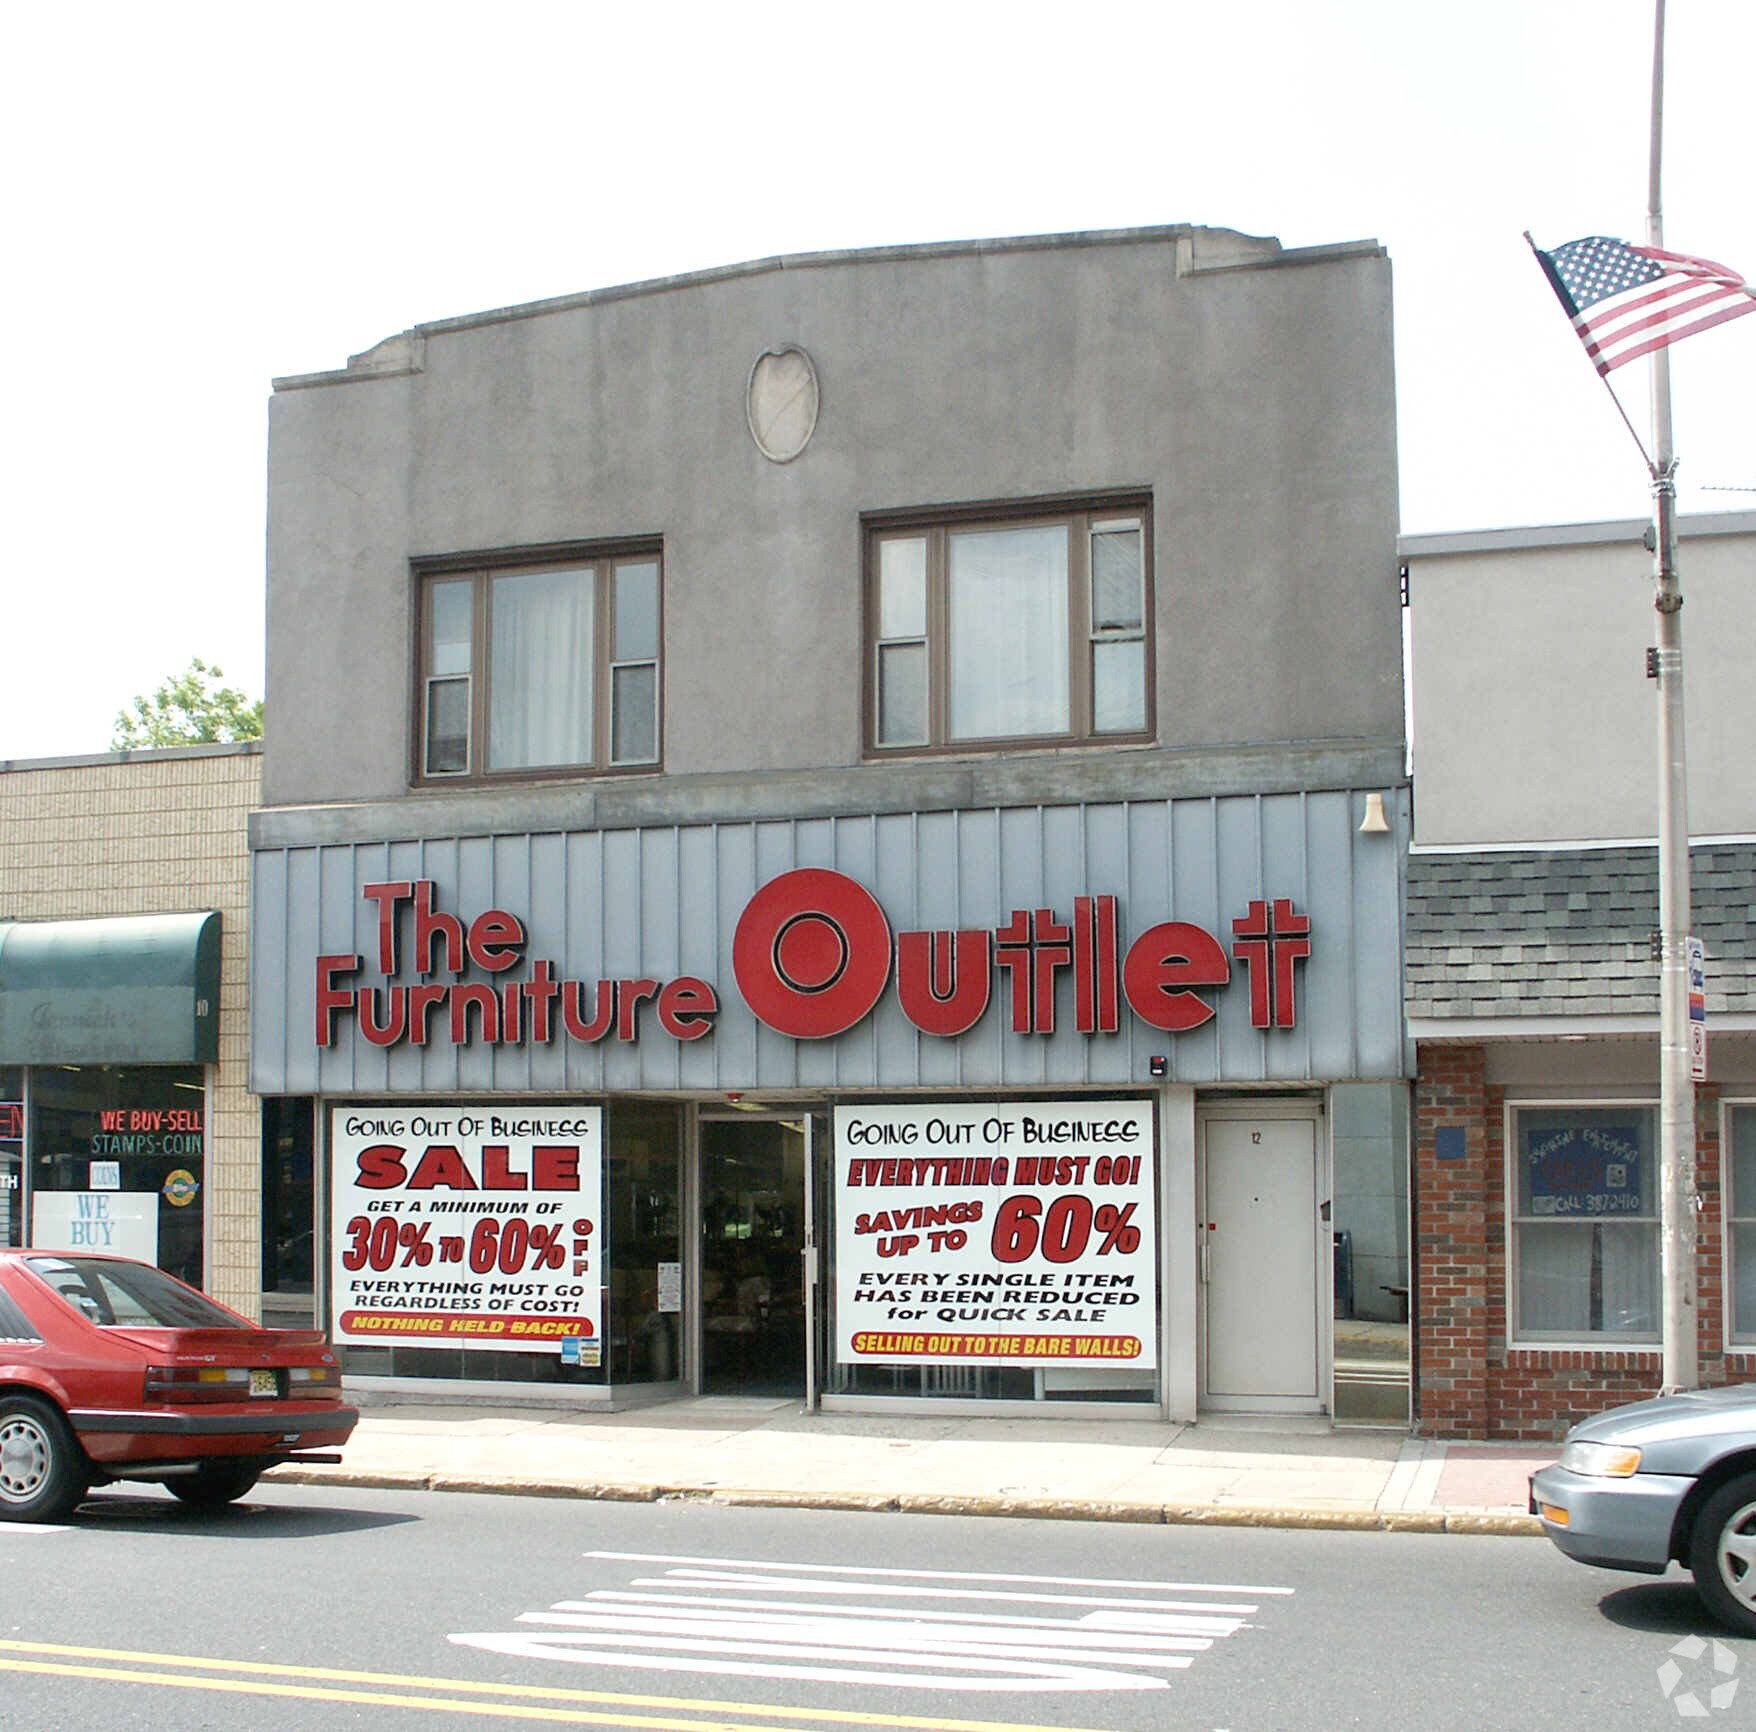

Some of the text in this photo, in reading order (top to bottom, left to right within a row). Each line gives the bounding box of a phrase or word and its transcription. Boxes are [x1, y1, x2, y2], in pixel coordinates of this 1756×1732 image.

[362, 878, 528, 975] The
[316, 867, 1311, 1048] Furniture Outlet
[101, 1110, 126, 1131] WE
[1252, 1132, 1261, 1144] 12
[354, 1144, 581, 1192] SALE
[847, 1156, 1141, 1187] EVERYTHING MUST GO!
[76, 1194, 110, 1219] WE
[367, 1201, 563, 1214] GET A MINIMUM OF
[71, 1221, 115, 1245] BUY
[855, 1194, 1141, 1264] SAVINGS 60%
[343, 1216, 566, 1275] 30% TO 60%
[573, 1219, 593, 1277] OFF
[877, 1229, 967, 1258] UP TO
[350, 1281, 584, 1297] EVERYTHING MUST GO
[859, 1273, 1134, 1287] EVERY SINGLE ITEM
[355, 1295, 580, 1313] REGARDLESS OF COST!
[854, 1290, 1140, 1305] HAS BEEN REDUCED
[351, 1316, 581, 1335] NOTHING HELD BACK!
[887, 1307, 1106, 1322] for QUICK SALE
[855, 1335, 1139, 1356] SELLING OUT TO THE BARE WALLS!
